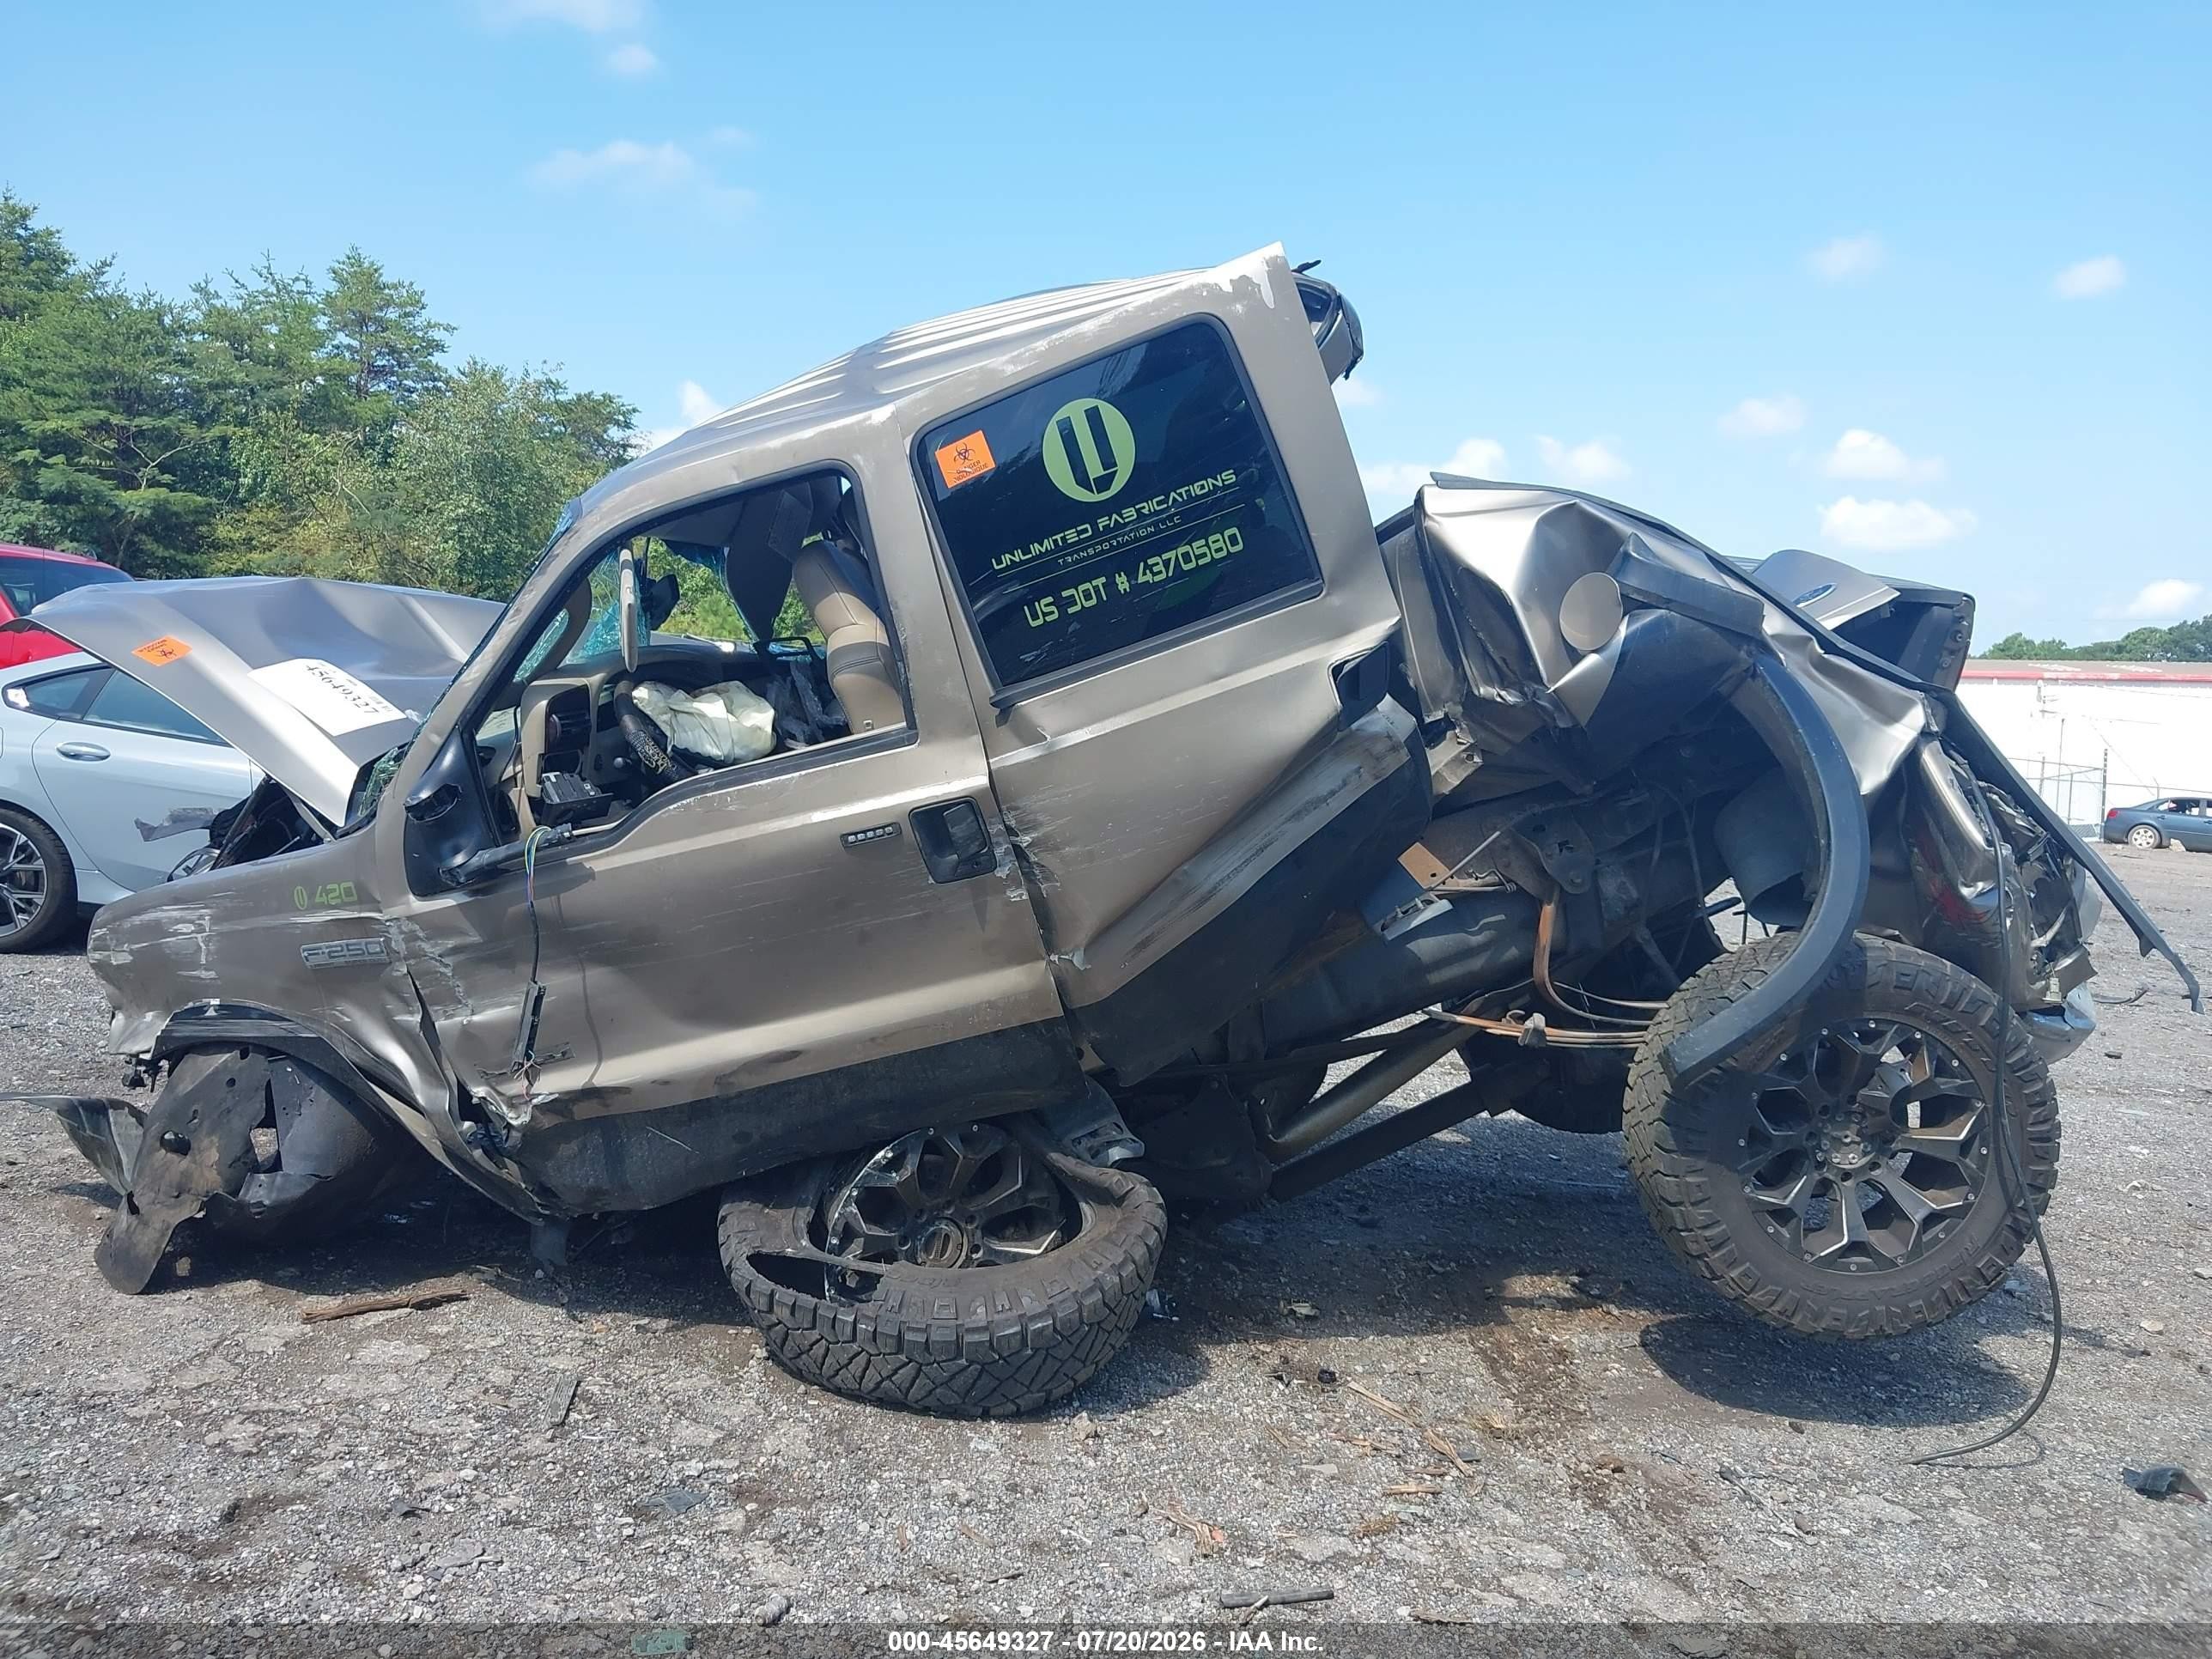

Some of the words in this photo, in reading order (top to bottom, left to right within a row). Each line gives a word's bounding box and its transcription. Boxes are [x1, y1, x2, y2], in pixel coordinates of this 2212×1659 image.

[992, 523, 1092, 569] UNLIMITED
[1097, 469, 1237, 532] FABRICATIONS
[1057, 525, 1155, 566] TRANSPORTATION
[1158, 515, 1182, 529] LLC
[1024, 596, 1059, 628] US
[1060, 576, 1108, 615] DOT
[1115, 571, 1131, 594] #
[1137, 526, 1244, 585] 4370580
[306, 665, 380, 714] 45649327
[315, 881, 358, 905] 420
